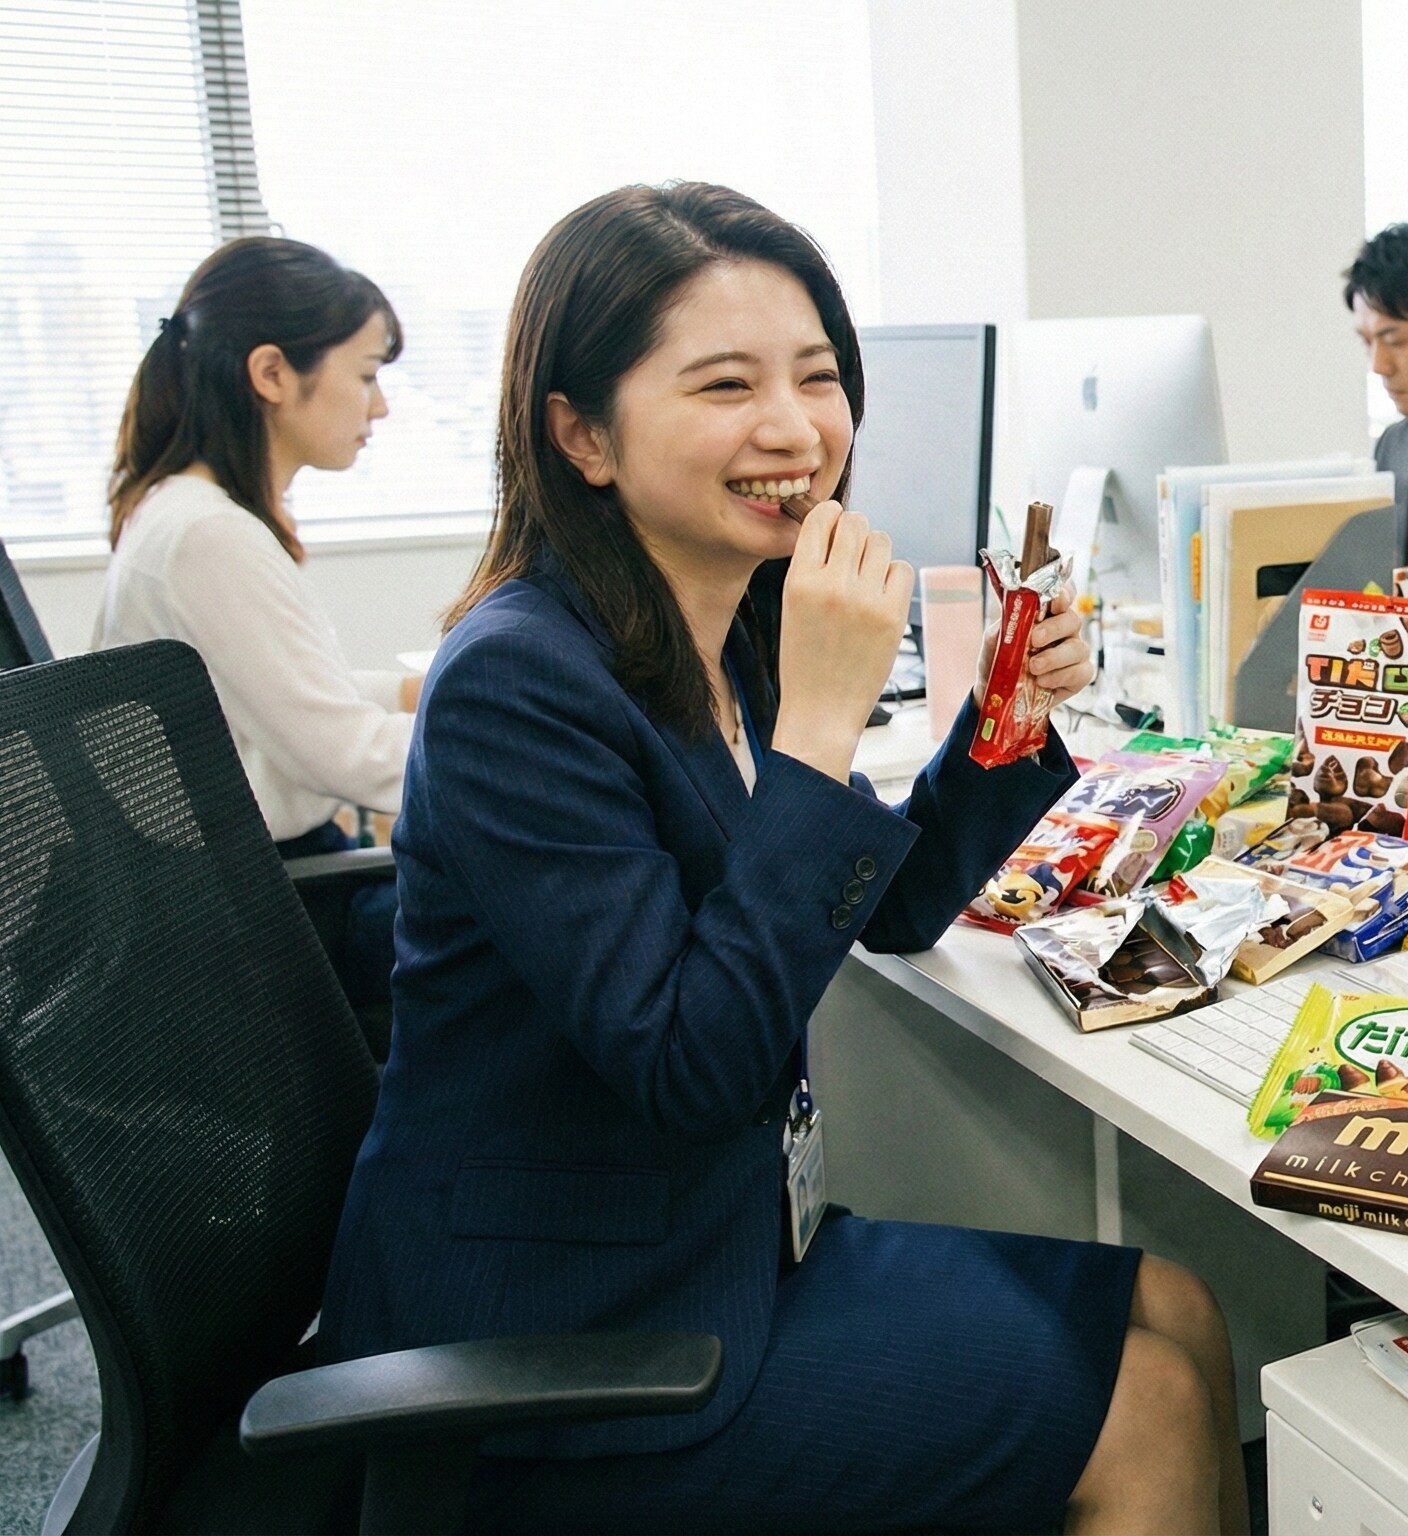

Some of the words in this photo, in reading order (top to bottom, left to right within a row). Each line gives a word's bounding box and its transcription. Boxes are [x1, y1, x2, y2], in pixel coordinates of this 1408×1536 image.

[1311, 689, 1397, 724] チョコ
[1363, 1209, 1400, 1228] milk
